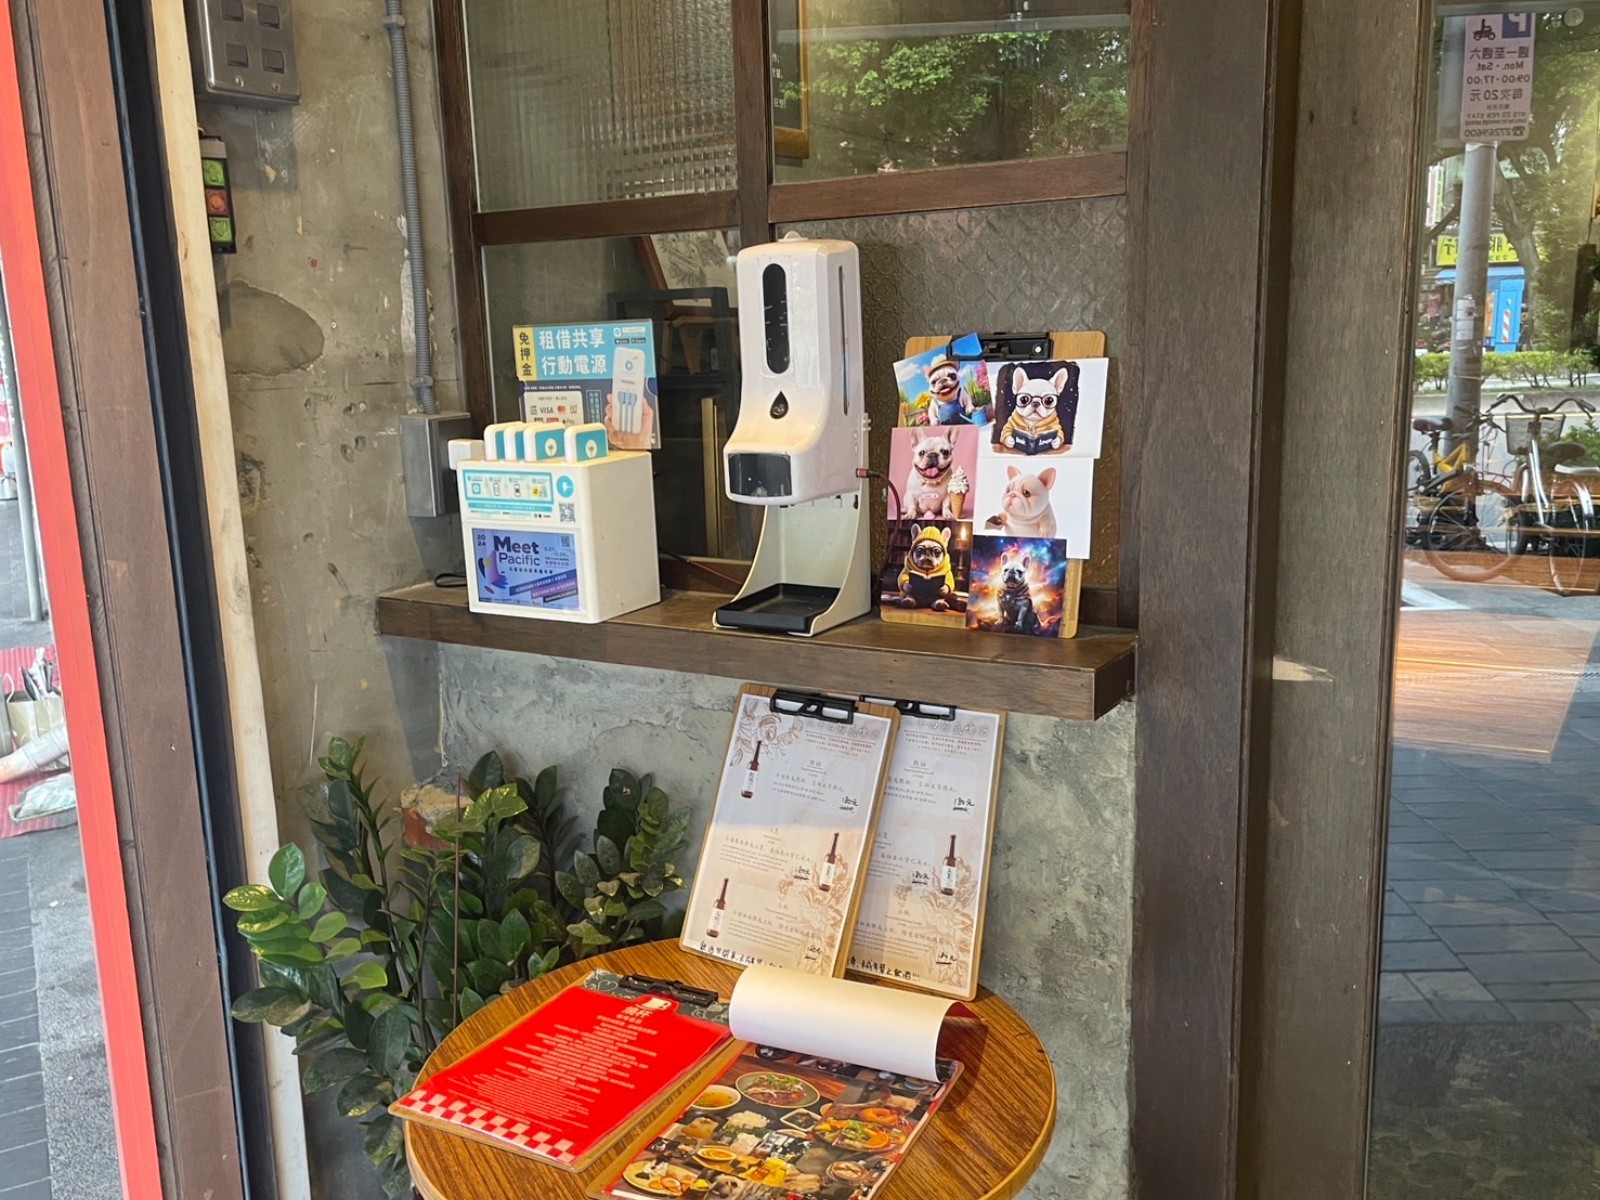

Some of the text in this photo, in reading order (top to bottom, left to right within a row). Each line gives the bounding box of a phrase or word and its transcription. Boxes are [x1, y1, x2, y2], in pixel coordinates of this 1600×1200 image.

[538, 328, 605, 350] 租借共享
[519, 332, 533, 376] 免押金
[541, 354, 607, 376] 行動電源
[539, 404, 554, 414] VISA
[493, 535, 540, 555] Meet
[498, 552, 541, 567] Pacific
